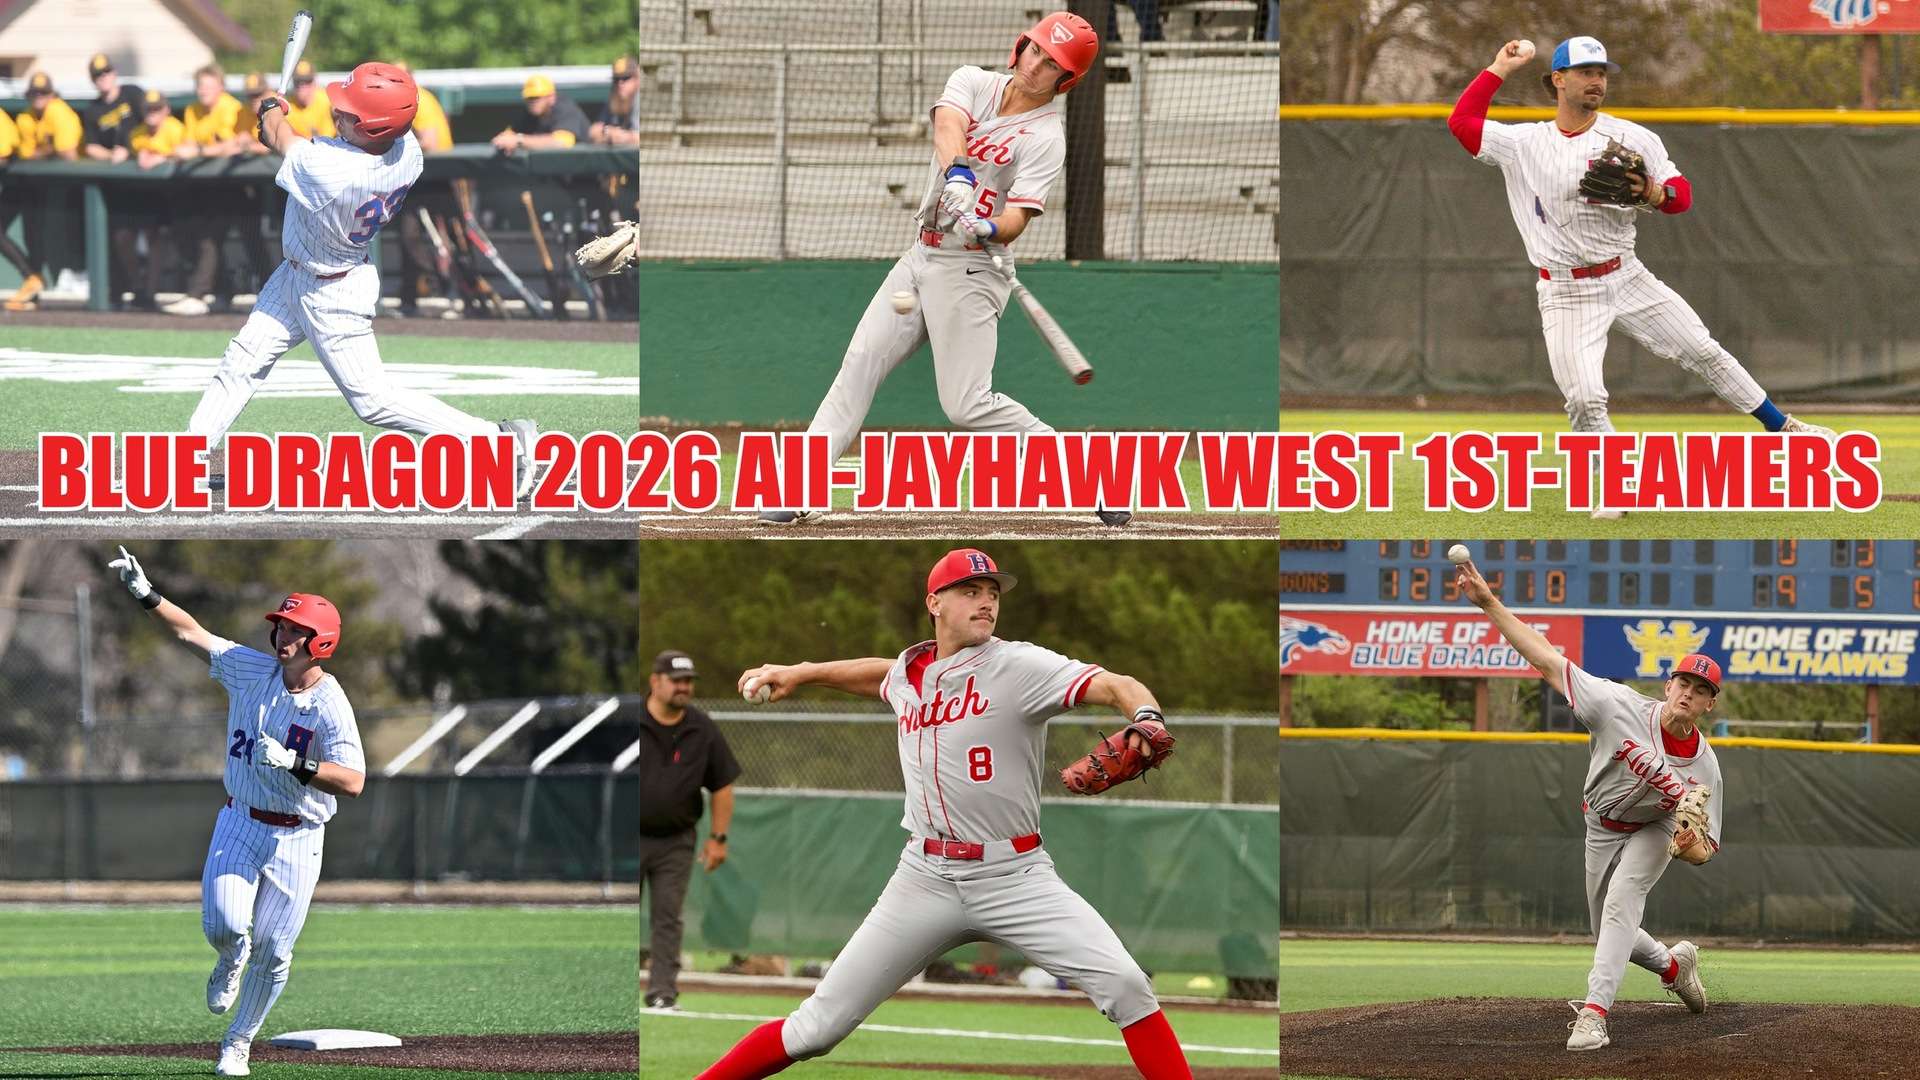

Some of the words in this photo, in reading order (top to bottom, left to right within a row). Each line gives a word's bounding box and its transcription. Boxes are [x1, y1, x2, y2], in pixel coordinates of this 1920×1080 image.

[966, 552, 991, 573] H
[1411, 568, 1429, 600] 2
[1777, 574, 1796, 607] 9
[1855, 575, 1874, 608] 5
[1366, 620, 1447, 644] HOME
[1452, 621, 1491, 645] OF
[1721, 625, 1811, 650] HOME
[1814, 627, 1857, 652] OF
[1860, 629, 1918, 653] THE
[1350, 642, 1425, 669] BLUE
[1428, 643, 1566, 670] DRAGO
[1728, 650, 1908, 678] SALTHAWKS
[967, 744, 995, 783] 8
[1613, 739, 1687, 802] Hutc
